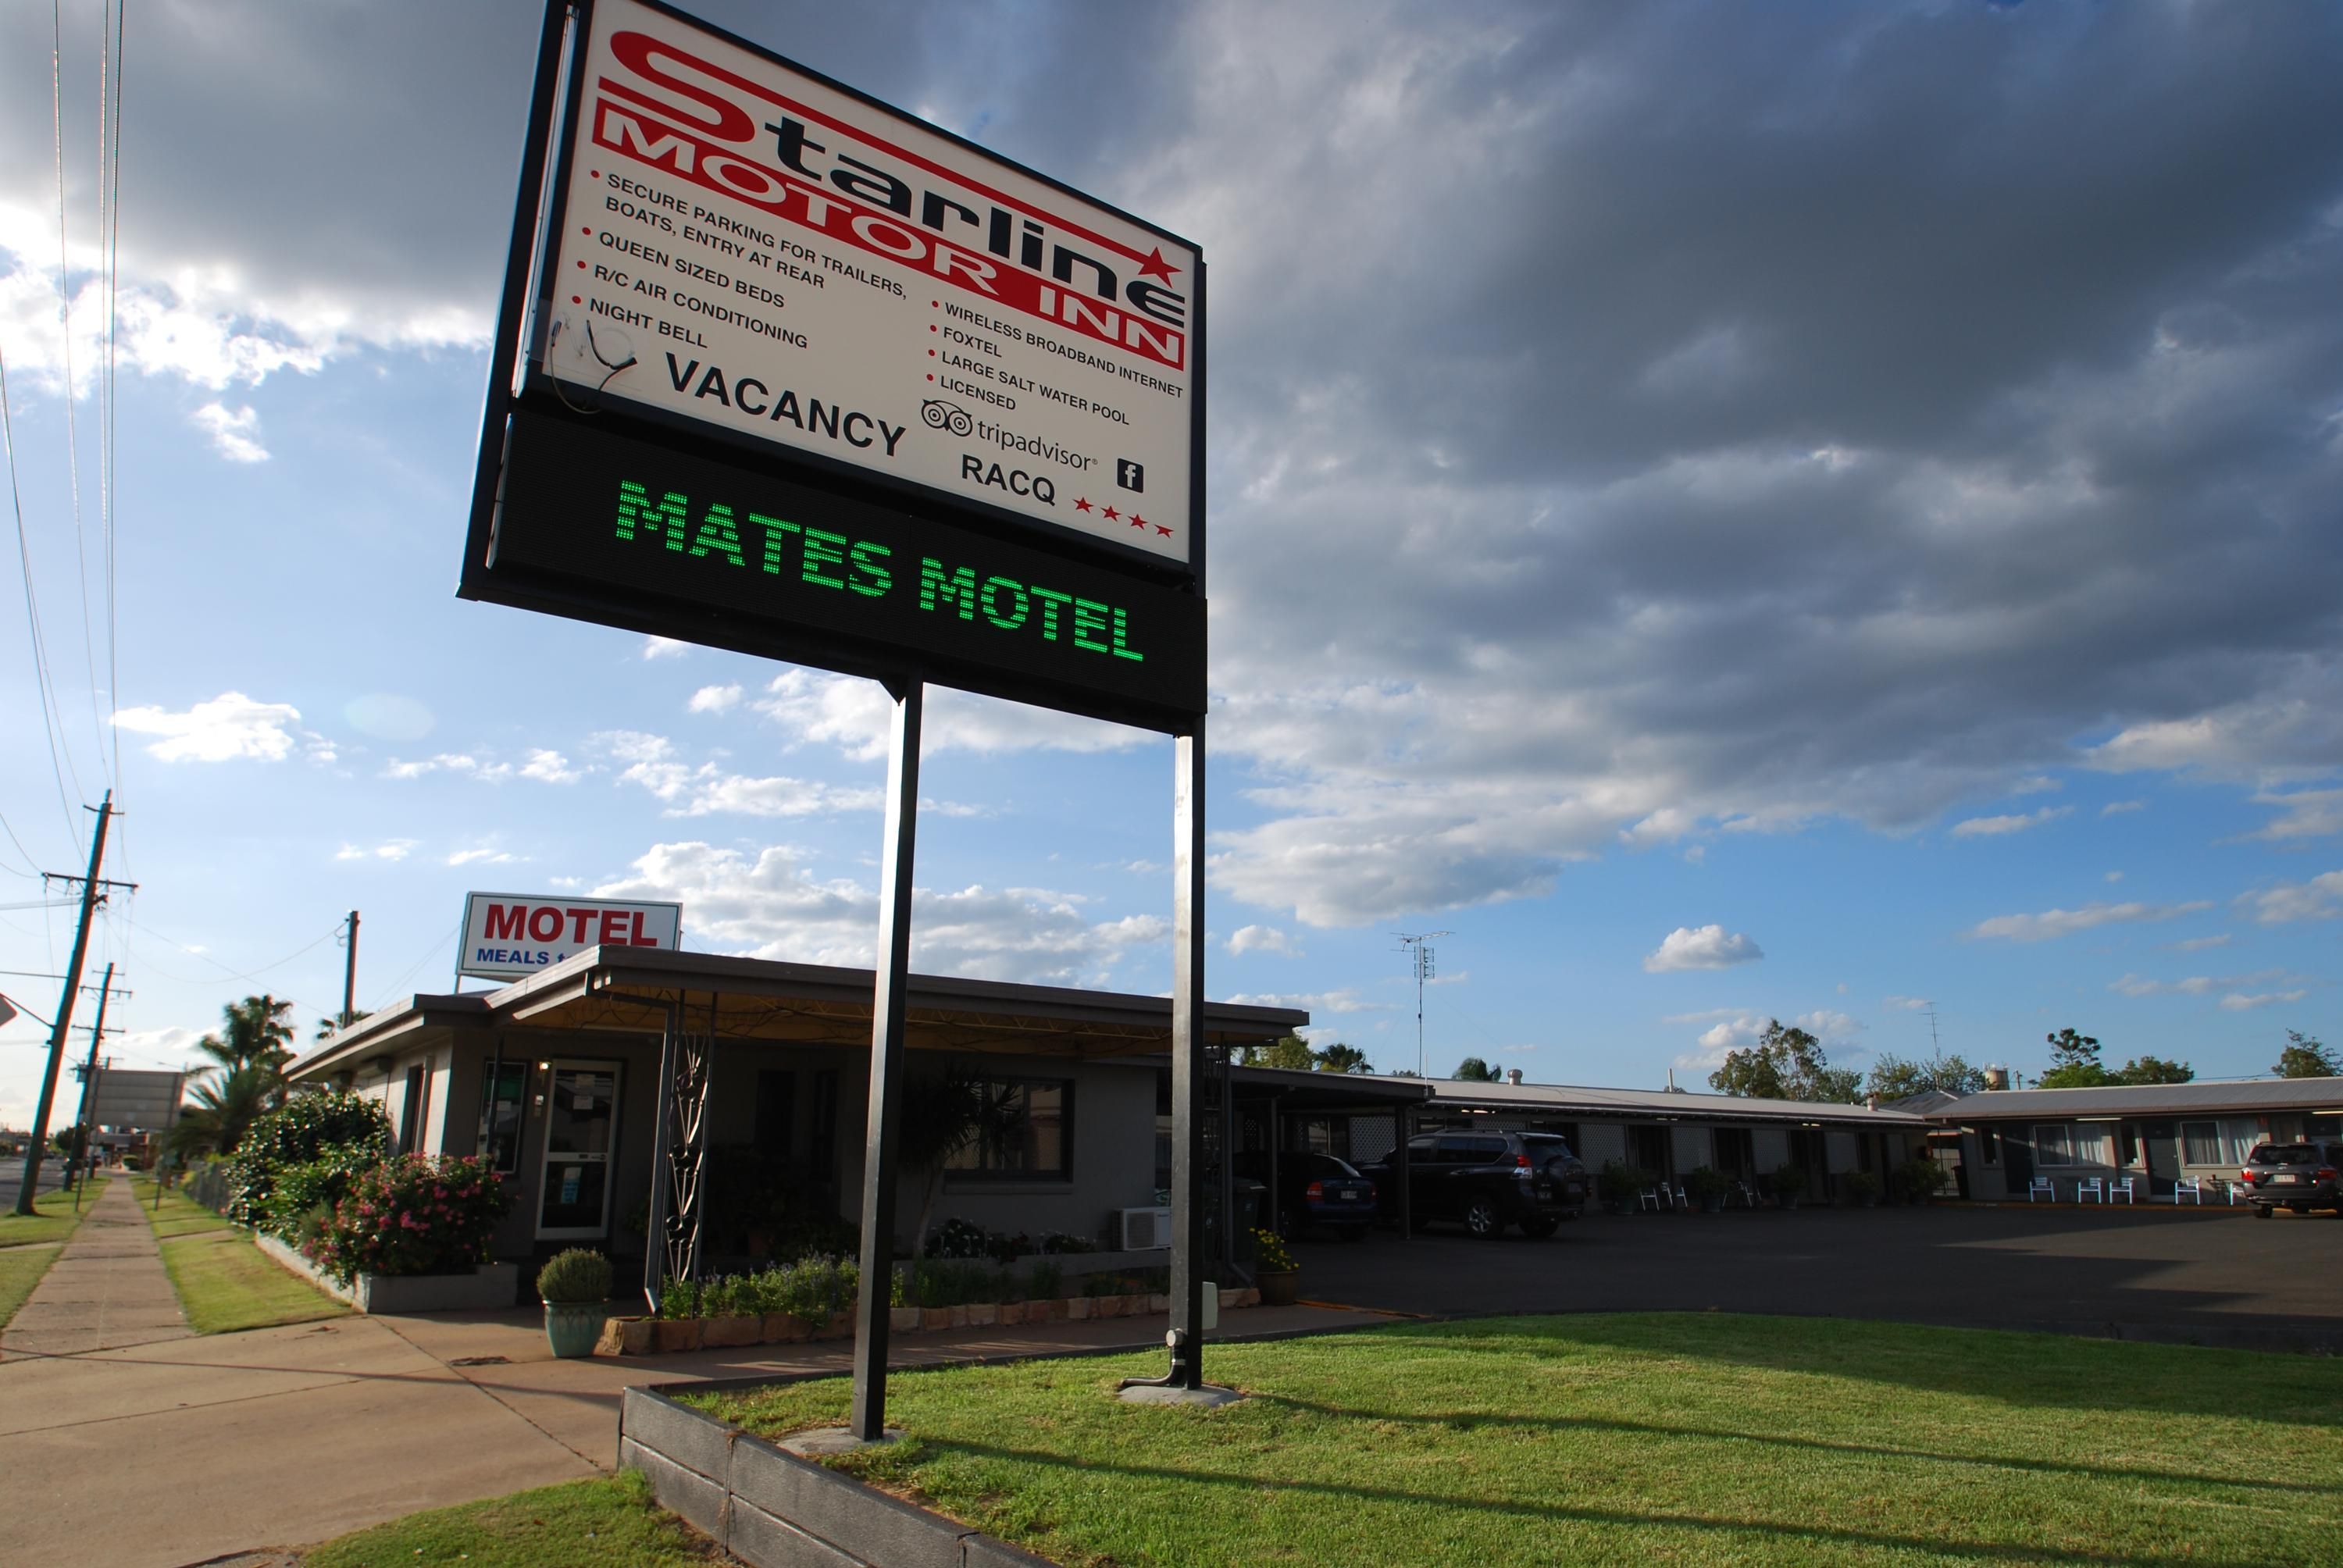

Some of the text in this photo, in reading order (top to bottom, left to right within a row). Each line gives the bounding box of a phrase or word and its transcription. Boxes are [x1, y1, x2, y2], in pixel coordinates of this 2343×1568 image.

[598, 30, 1186, 329] Starline
[600, 231, 785, 308] QUEEN SIZED BEDS
[602, 107, 1179, 364] MOTOR INN
[605, 197, 825, 289] BOATS, ENTRY AT REAR
[608, 173, 907, 300] SECURE PARKING FOR TRAILERS,
[590, 298, 708, 348] NIGHT BELL
[594, 265, 808, 349] R/C AIR CONDITIONING
[943, 326, 1002, 358] FOXTEL
[942, 351, 1129, 426] LARGE SALT WATER POOL
[946, 302, 1183, 398] WIRELESS BROADBAND INTERNET
[665, 351, 906, 457] VACANCY
[940, 376, 1016, 411] LICENSED
[961, 454, 1056, 507] RACQ
[977, 420, 1092, 471] tripadvisor
[616, 479, 1143, 662] MATES MOTEL
[476, 948, 550, 965] MEALS
[483, 903, 658, 946] MOTEL
